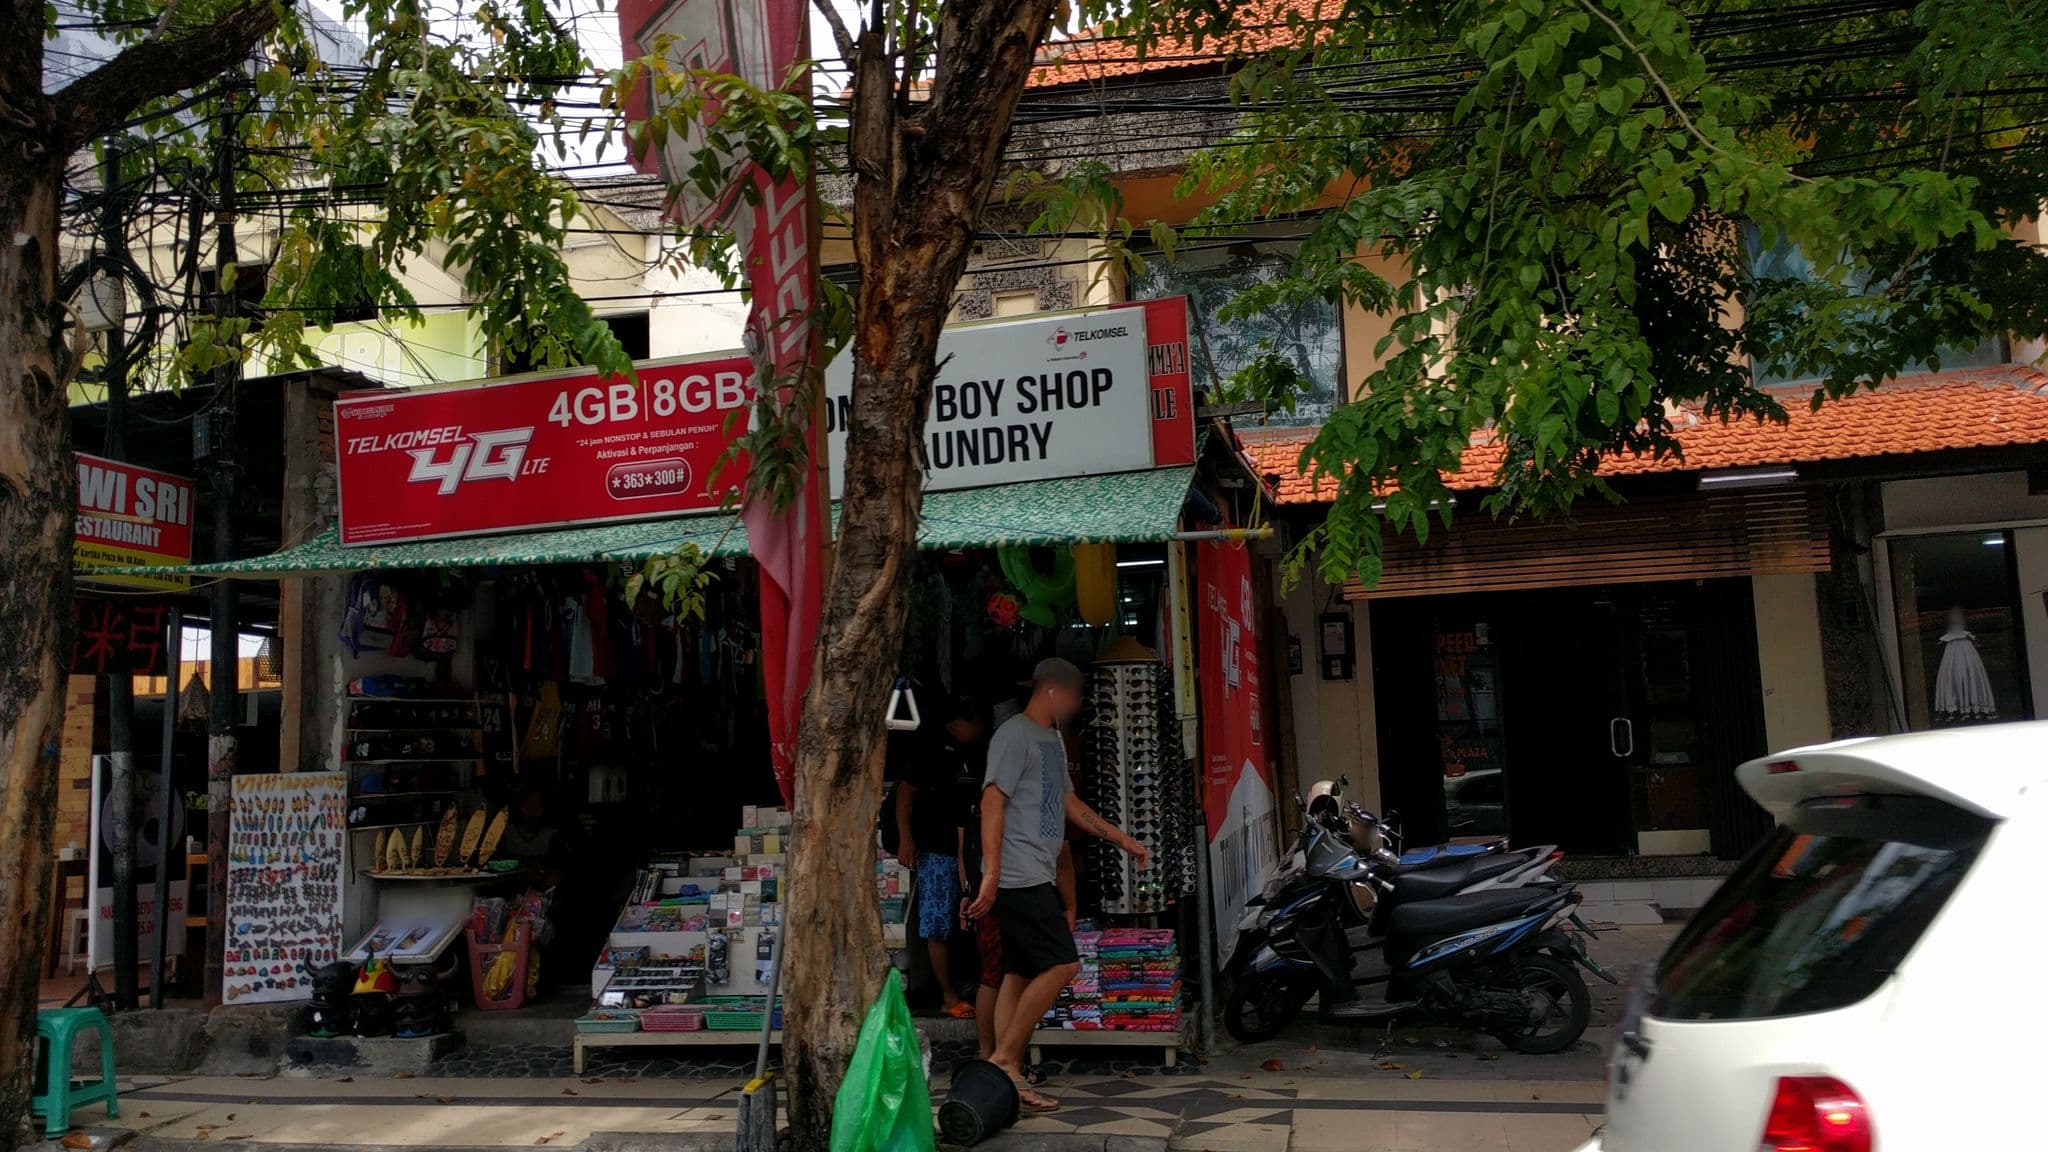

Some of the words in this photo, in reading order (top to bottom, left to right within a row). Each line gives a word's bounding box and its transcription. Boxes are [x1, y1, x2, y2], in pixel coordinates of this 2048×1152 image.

[1074, 327, 1129, 342] TELKOMSEL
[547, 384, 639, 428] 4GB
[652, 371, 747, 417] 8GB
[936, 378, 1005, 422] BOY
[1016, 367, 1113, 414] SHOP
[347, 425, 468, 455] TELKOMSEL
[596, 448, 630, 460] Aktivasi
[631, 446, 638, 456] &
[638, 441, 694, 455] Perpanjangan
[604, 432, 641, 443] NONSTOP
[649, 427, 687, 438] SEBULAN
[405, 426, 536, 496] 4G
[521, 457, 552, 476] LTE
[135, 477, 189, 526] SRI
